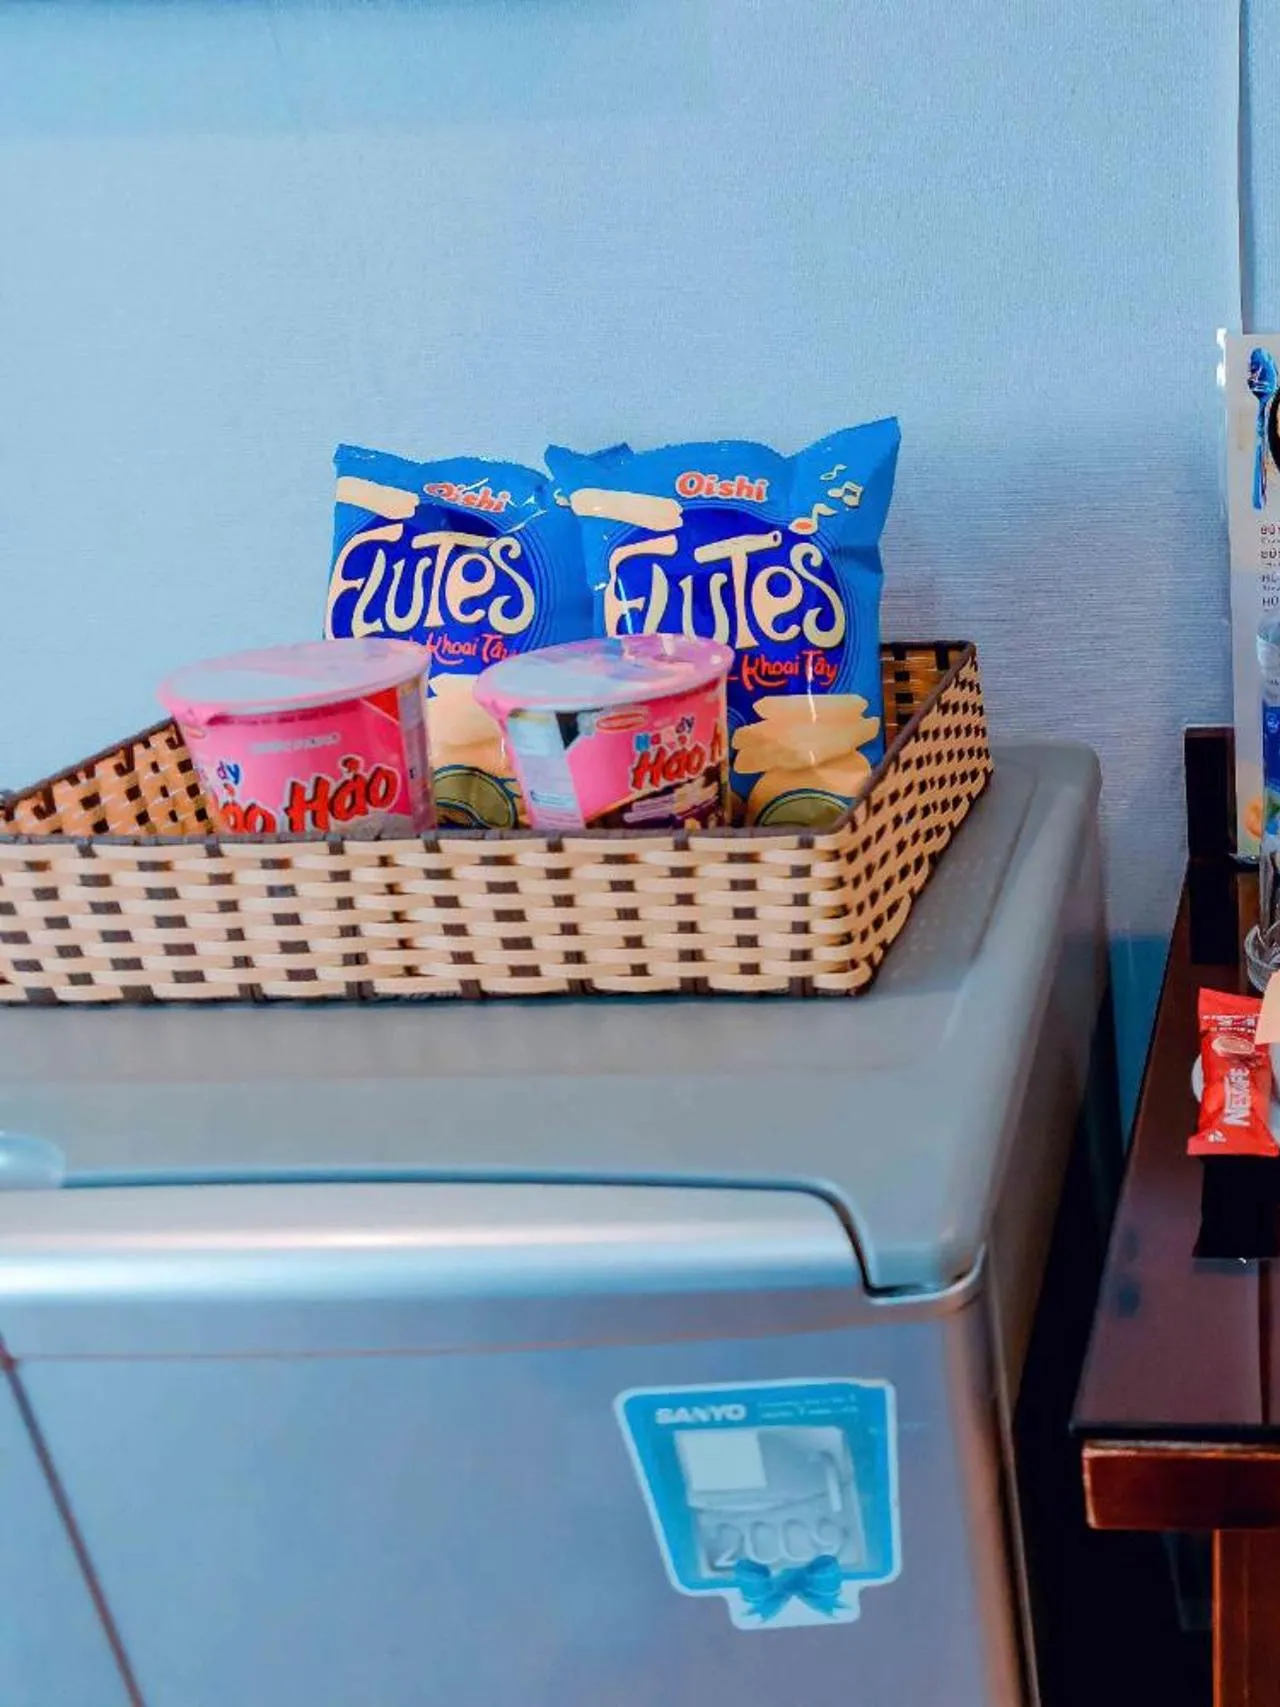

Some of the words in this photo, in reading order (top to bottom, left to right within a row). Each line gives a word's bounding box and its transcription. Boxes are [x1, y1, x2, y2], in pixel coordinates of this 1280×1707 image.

[676, 471, 769, 503] Oishi
[424, 631, 478, 666] Khoai
[741, 654, 802, 691] Khoai
[802, 650, 838, 687] Tây
[631, 733, 706, 790] Hảo
[285, 754, 399, 834] Hảo
[655, 1404, 747, 1424] SANYO
